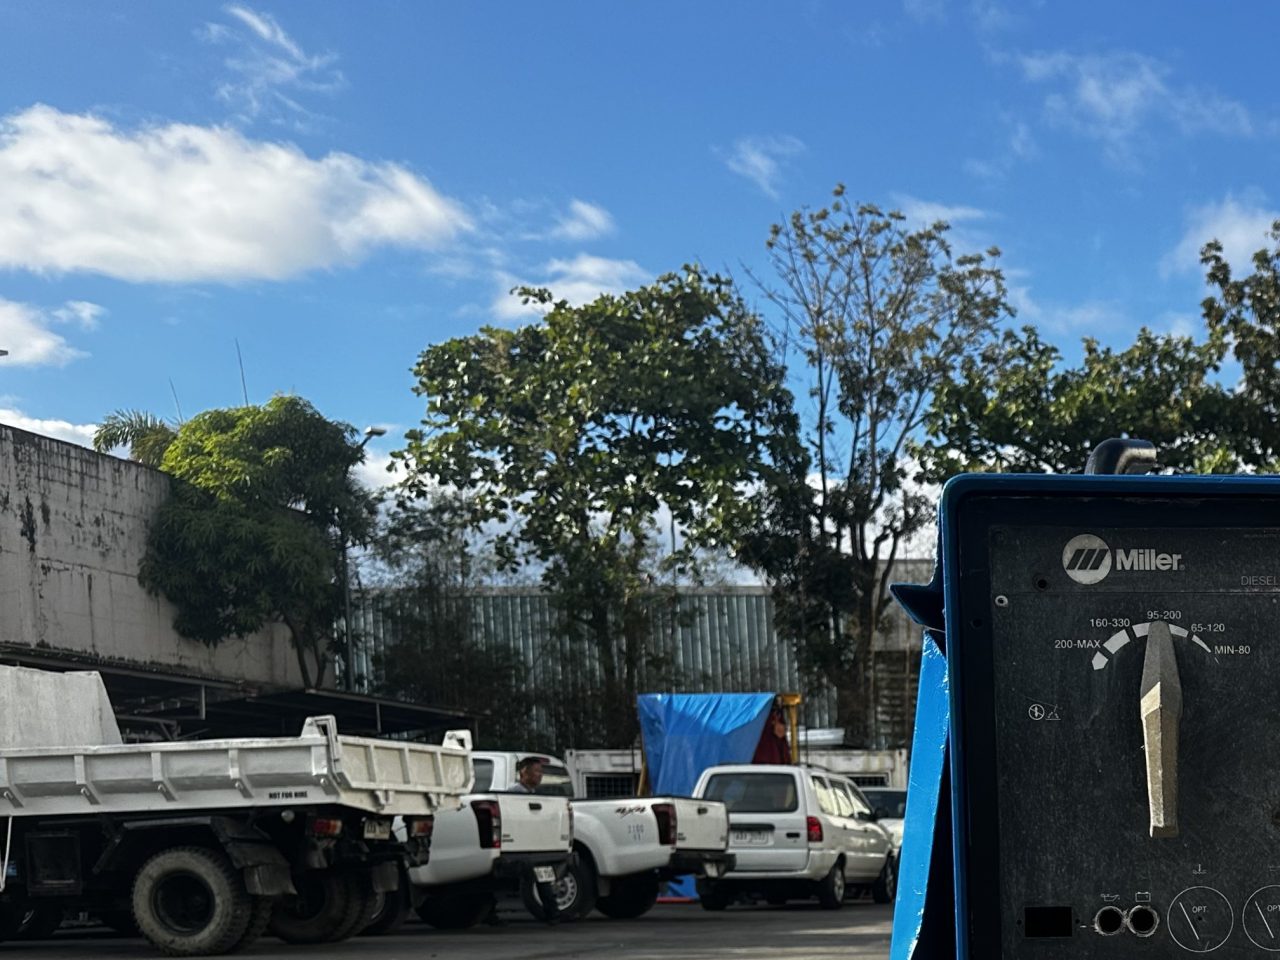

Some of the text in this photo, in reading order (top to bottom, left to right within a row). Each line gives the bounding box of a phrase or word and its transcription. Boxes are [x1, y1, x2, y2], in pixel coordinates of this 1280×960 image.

[1241, 576, 1279, 586] DIESEL
[1147, 610, 1182, 620] 95-200
[1089, 618, 1131, 628] 160-330
[1190, 623, 1226, 633] 65-120
[1054, 640, 1101, 649] 200-MAX
[1214, 646, 1251, 655] MIN-80
